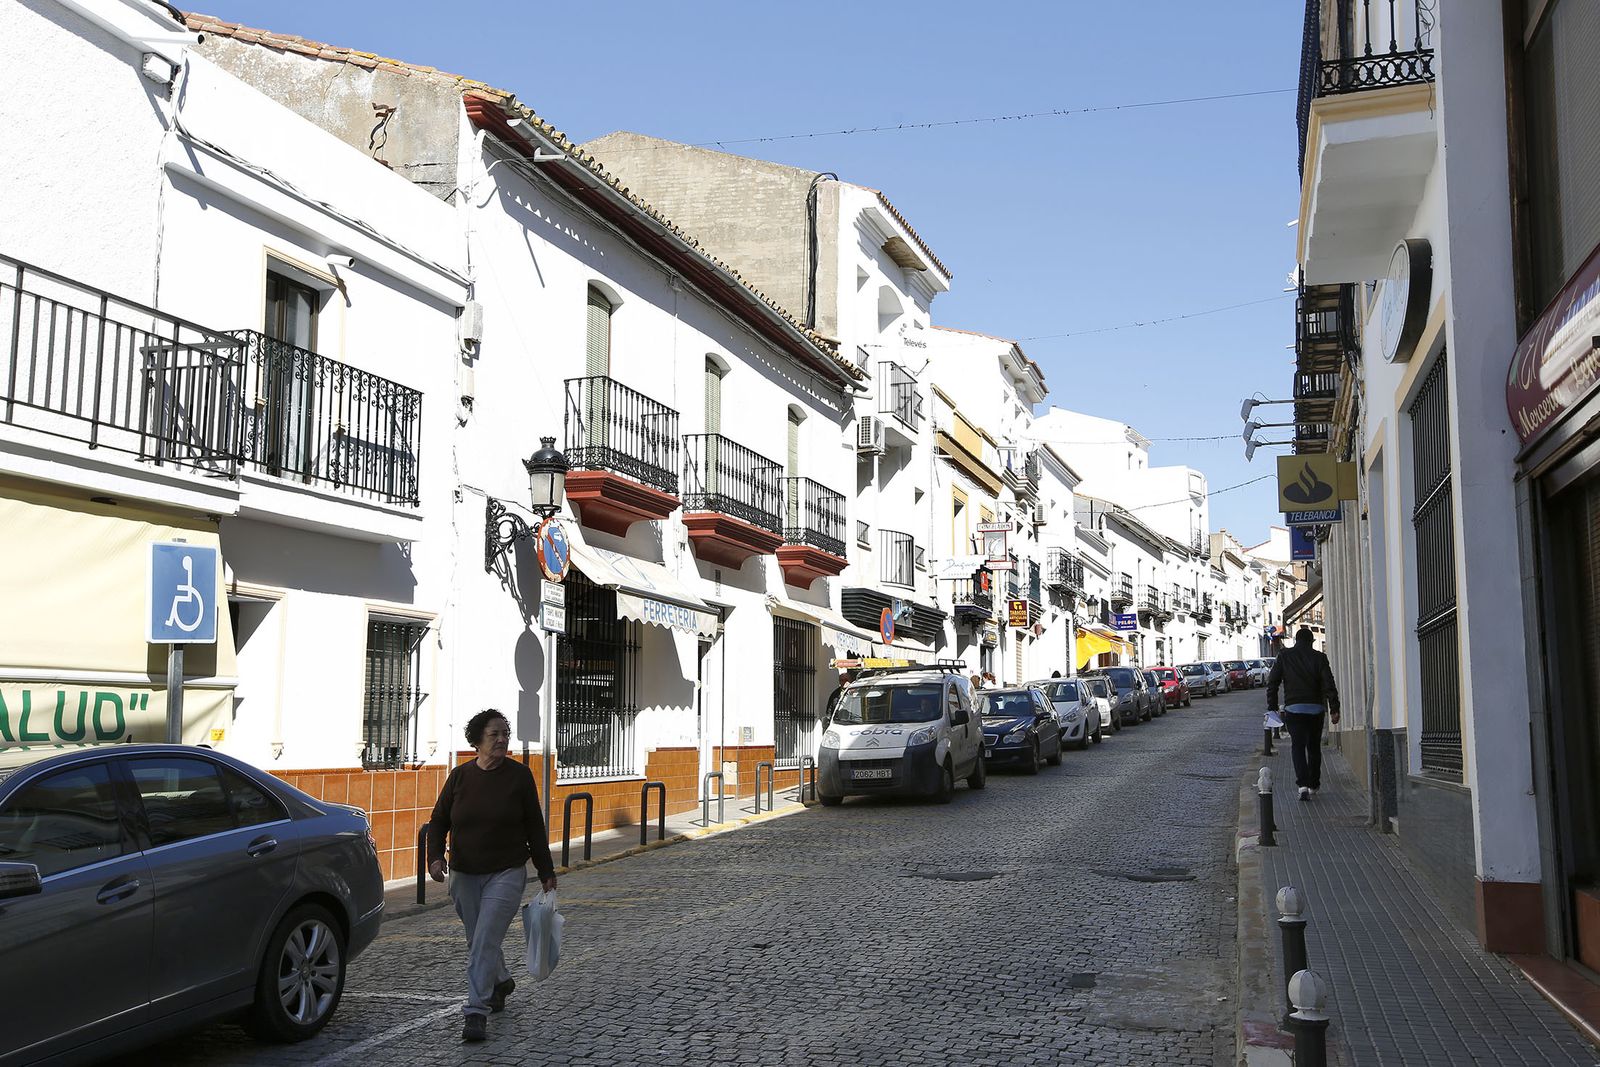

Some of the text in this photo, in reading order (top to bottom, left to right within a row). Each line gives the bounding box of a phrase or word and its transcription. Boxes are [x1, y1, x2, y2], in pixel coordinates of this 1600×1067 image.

[1290, 510, 1336, 522] TELEBANCO
[643, 599, 697, 629] FERRETERIA
[850, 727, 903, 736] cobra
